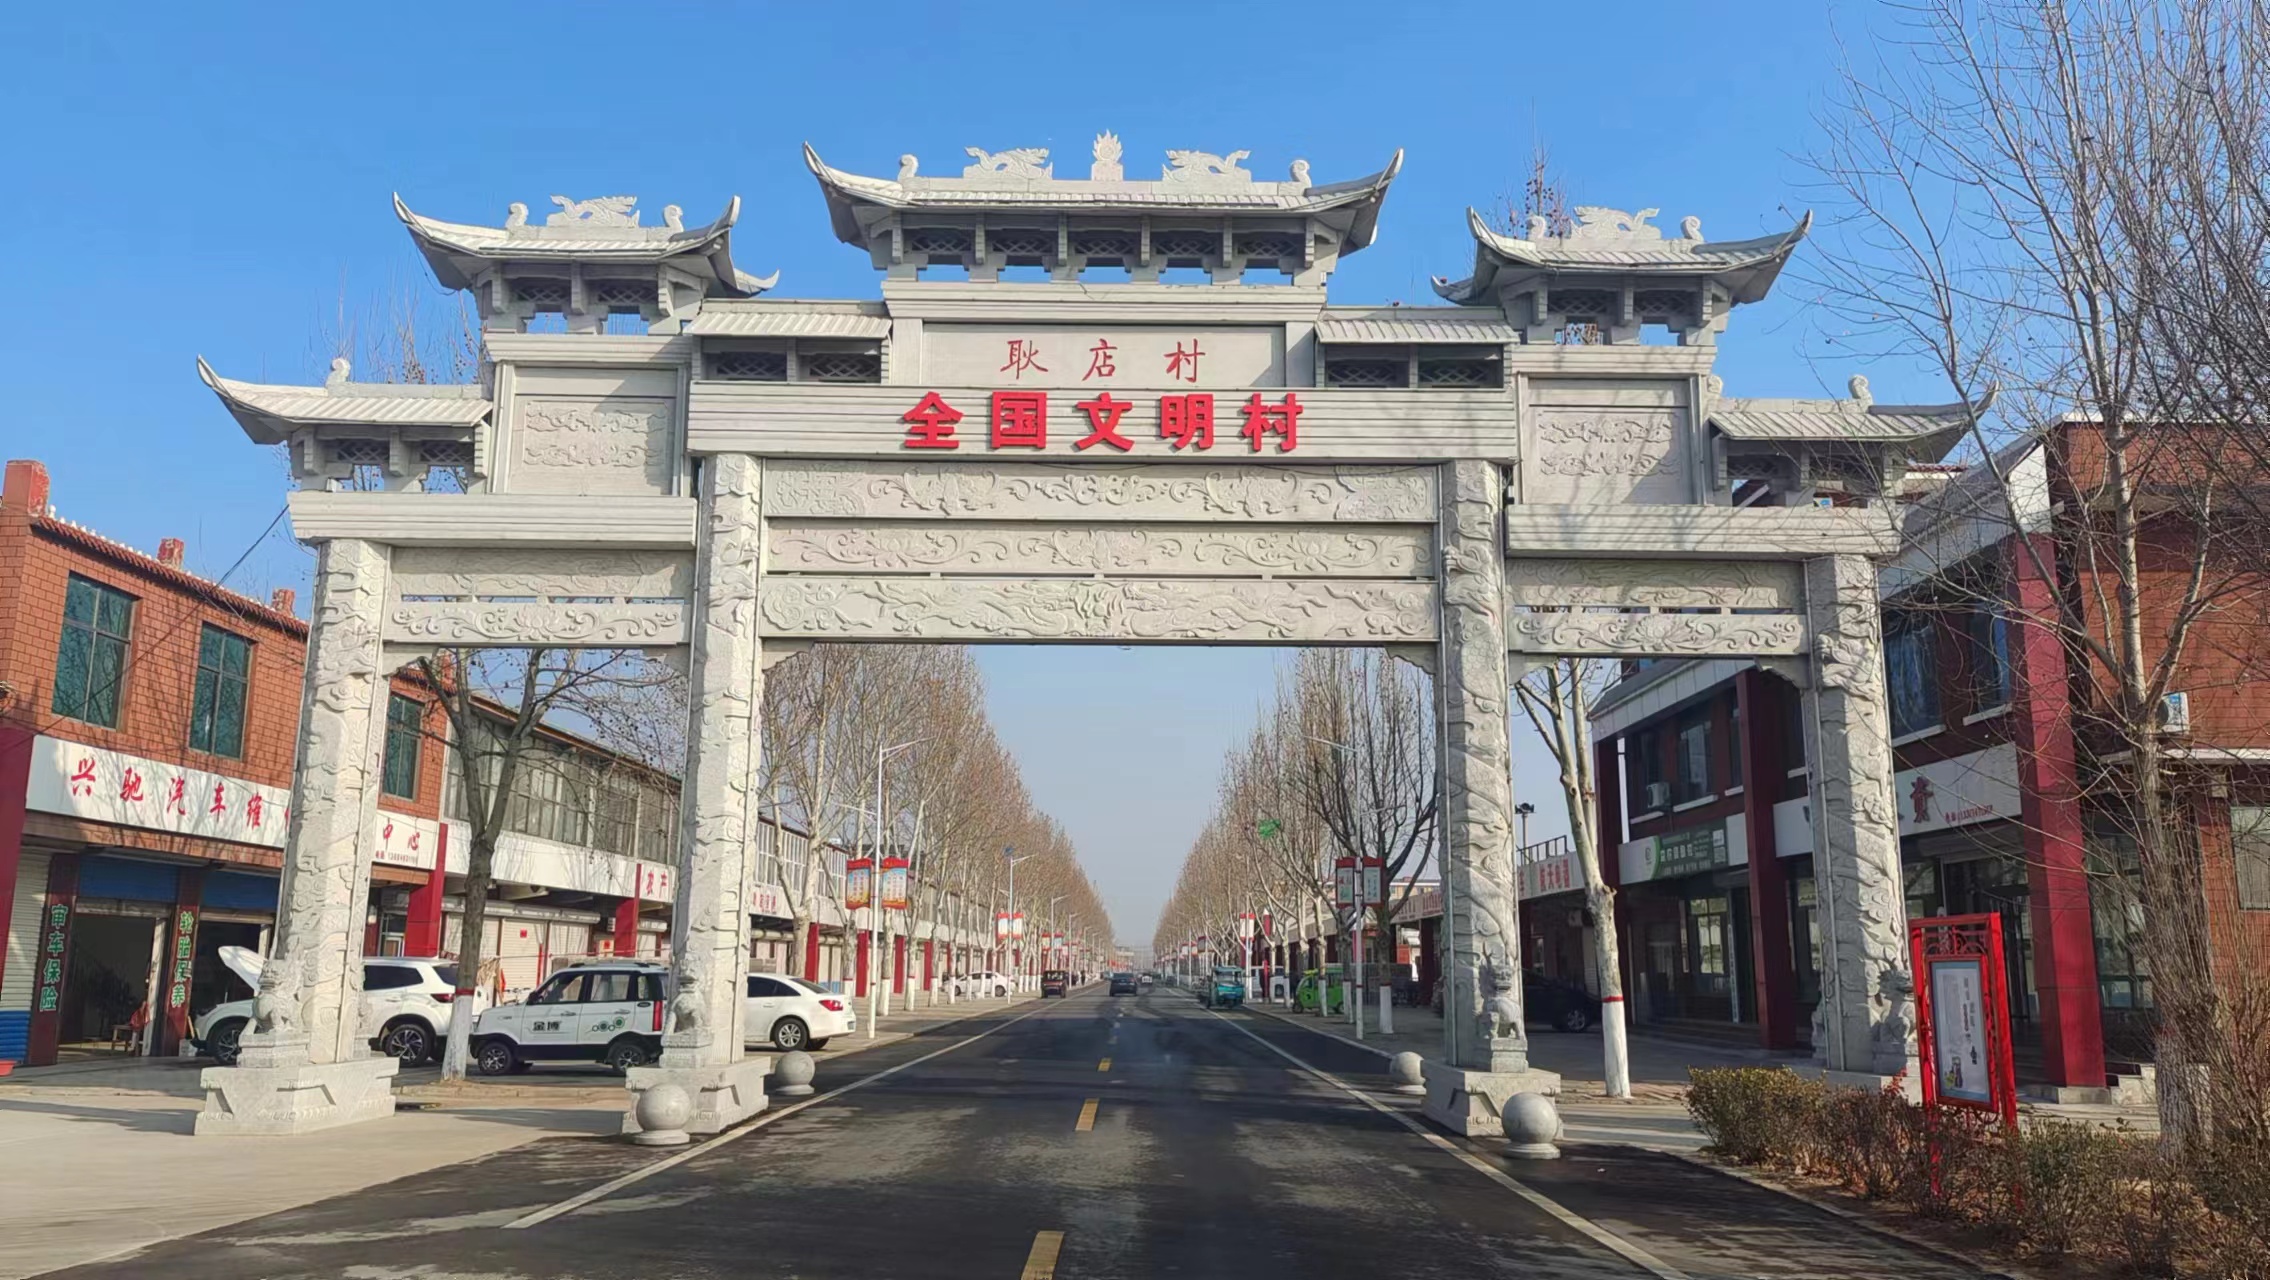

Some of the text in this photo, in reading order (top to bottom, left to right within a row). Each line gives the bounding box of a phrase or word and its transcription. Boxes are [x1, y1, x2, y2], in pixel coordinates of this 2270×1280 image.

[1001, 339, 1206, 384] 耿店村
[902, 390, 1304, 452] 全国文明村
[71, 757, 420, 851] 兴驰汽车维 中心
[40, 904, 68, 1012] 审车保险
[171, 911, 194, 1008] 轮胎保养
